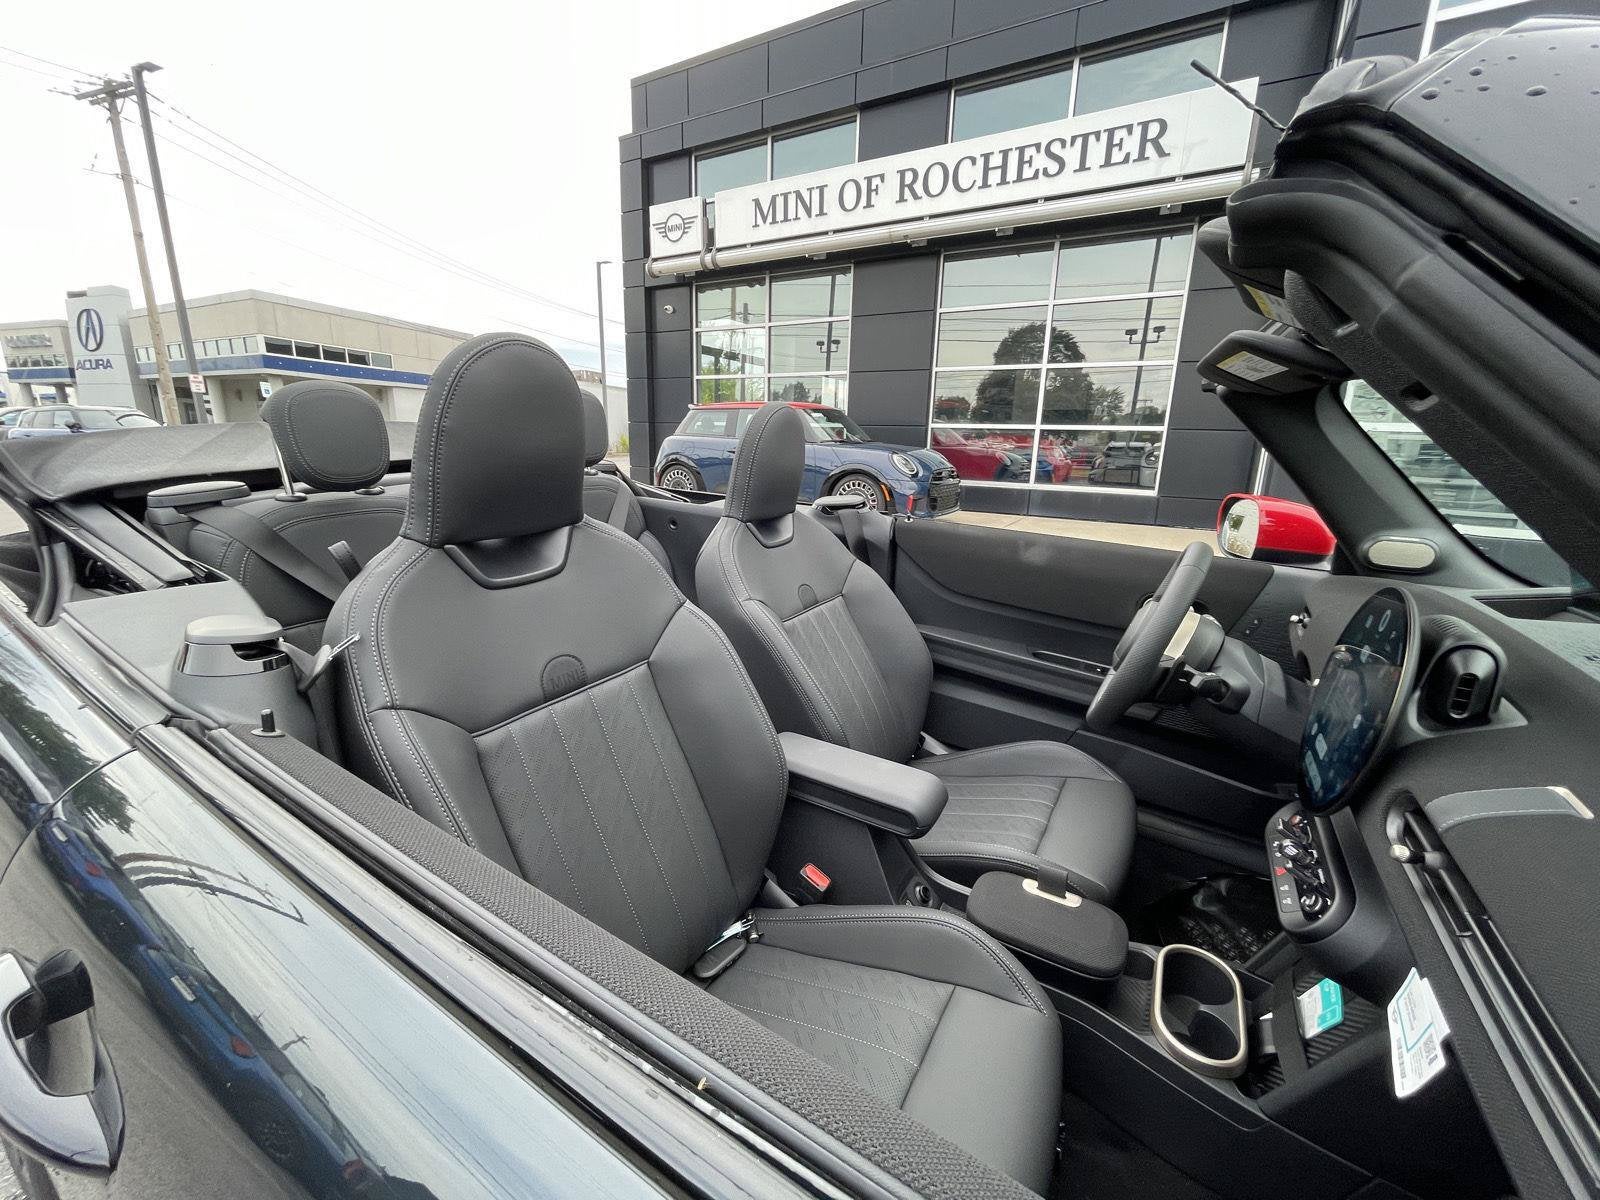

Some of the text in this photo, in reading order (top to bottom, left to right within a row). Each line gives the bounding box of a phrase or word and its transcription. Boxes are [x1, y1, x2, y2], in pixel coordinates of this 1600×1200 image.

[752, 117, 1171, 228] MINI OF ROCHESTER
[667, 223, 683, 233] MINI
[76, 359, 114, 370] ACURA
